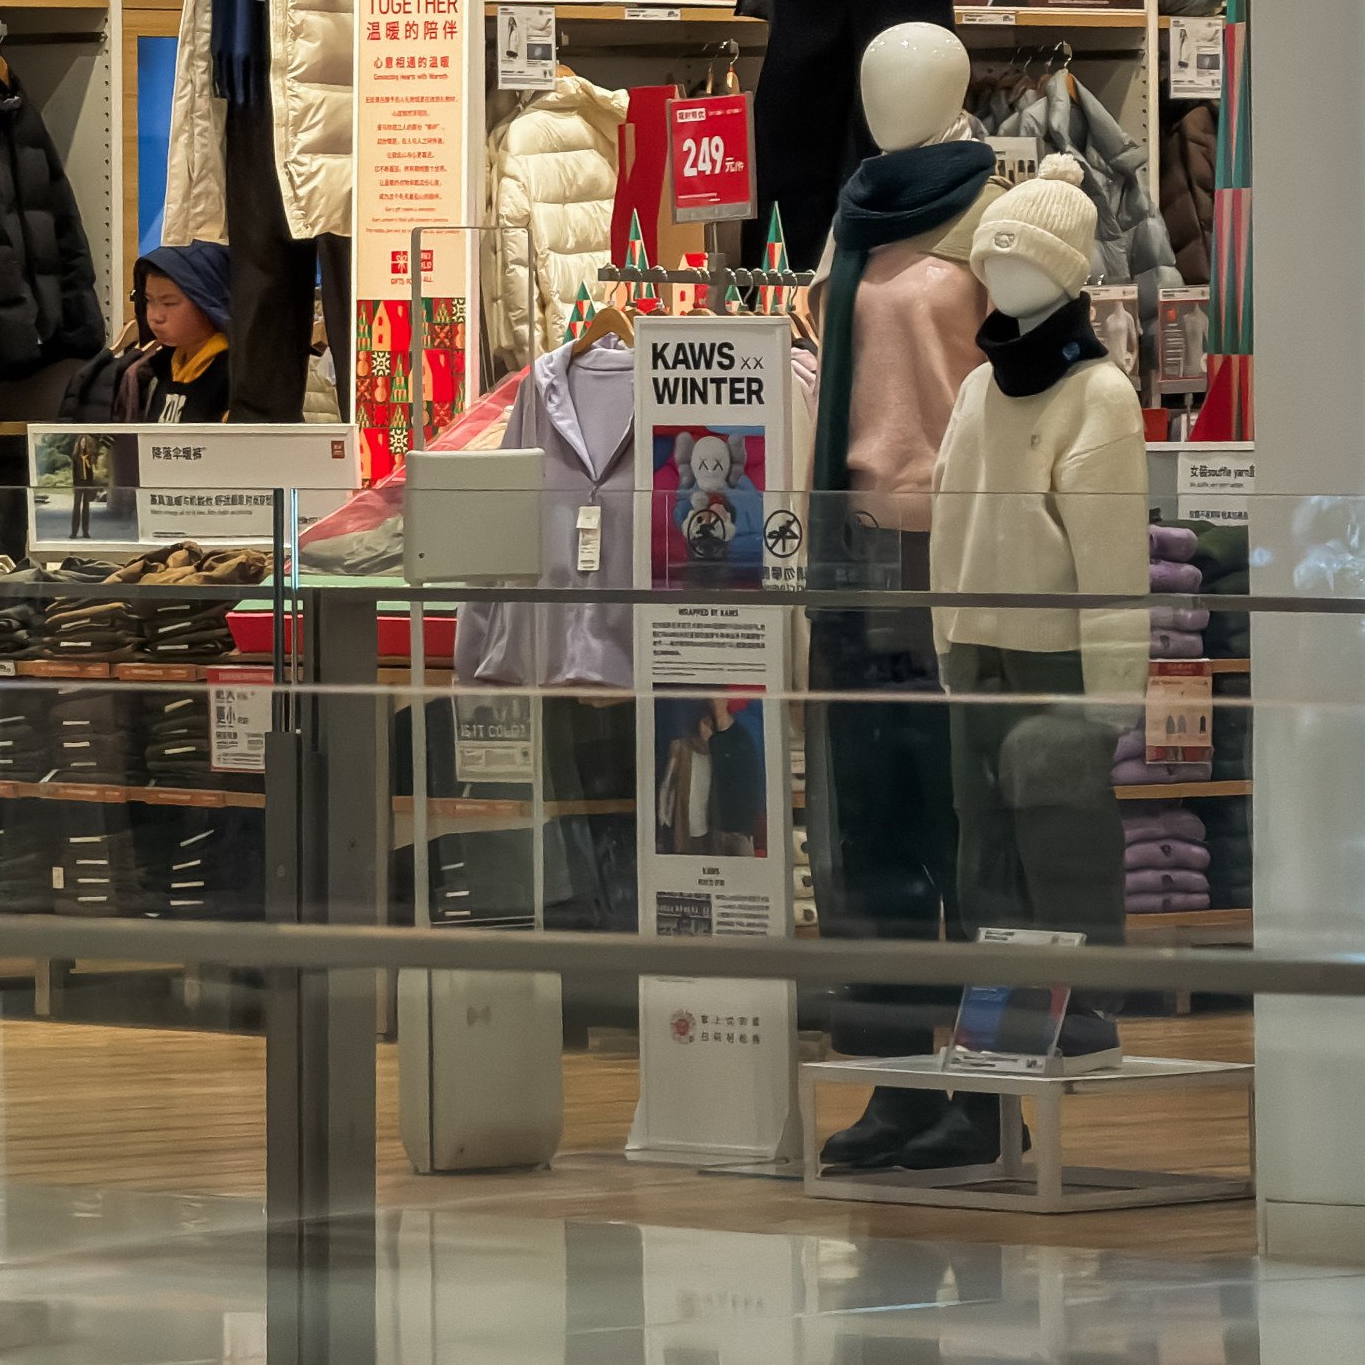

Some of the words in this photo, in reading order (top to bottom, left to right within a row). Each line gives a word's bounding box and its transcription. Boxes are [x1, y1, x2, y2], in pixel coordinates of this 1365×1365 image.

[367, 20, 458, 41] 温暖的陪伴
[682, 135, 724, 177] 249
[651, 342, 735, 370] KAWS
[652, 377, 765, 405] WINTER
